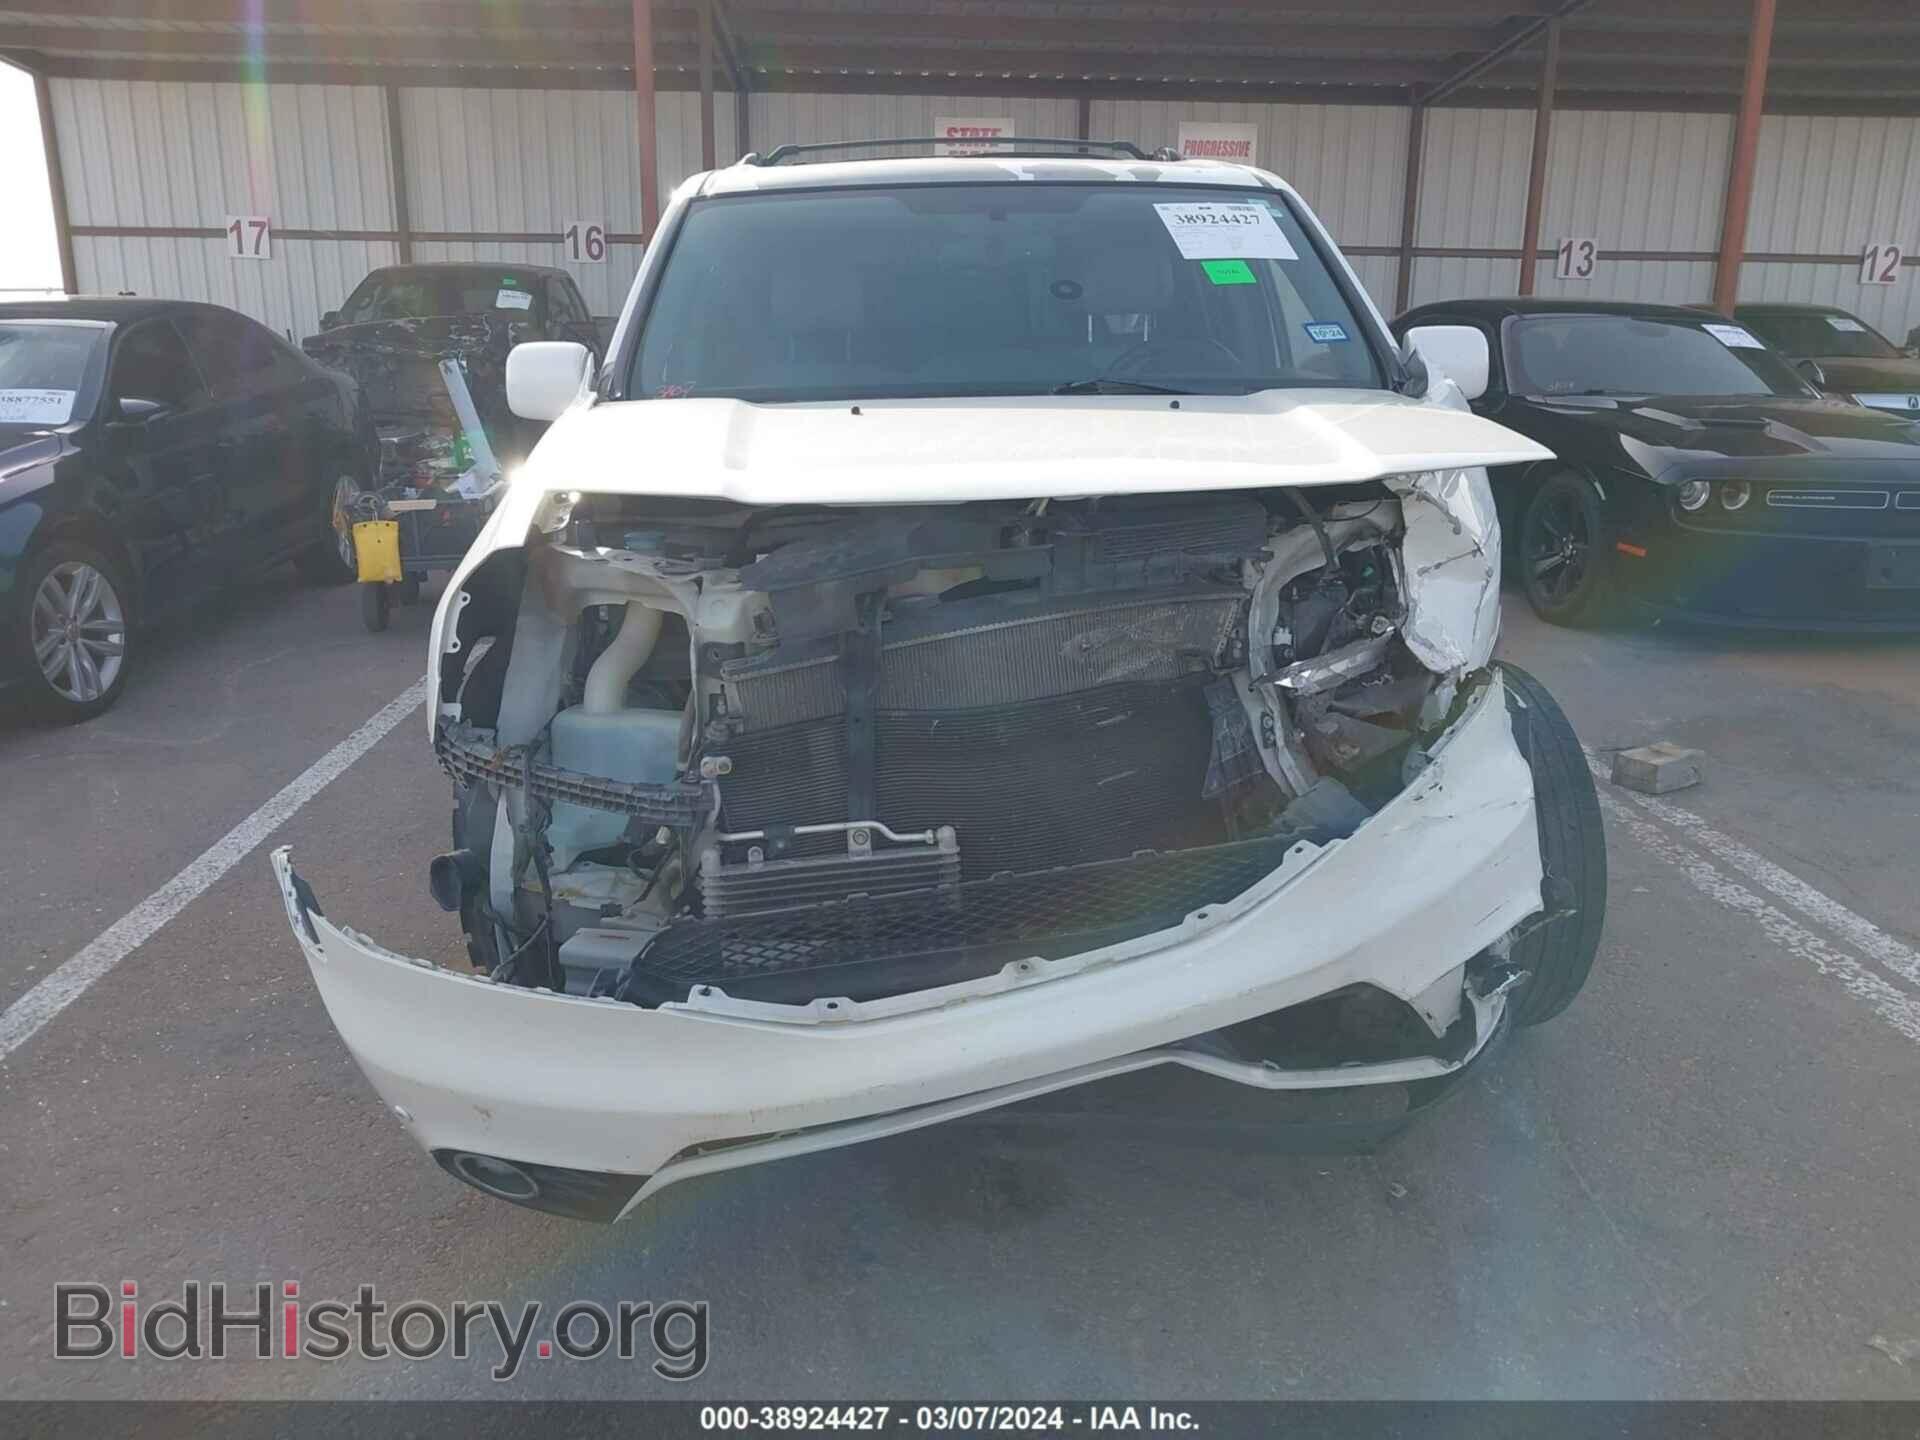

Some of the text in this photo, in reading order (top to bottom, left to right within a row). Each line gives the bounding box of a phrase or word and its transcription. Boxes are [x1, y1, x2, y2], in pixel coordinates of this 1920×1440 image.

[1184, 139, 1251, 157] PROGRESSIVE
[229, 219, 266, 255] 17
[1174, 214, 1260, 225] 38924427
[566, 225, 604, 261] 16
[1561, 240, 1594, 277] 13
[1866, 246, 1900, 282] 12
